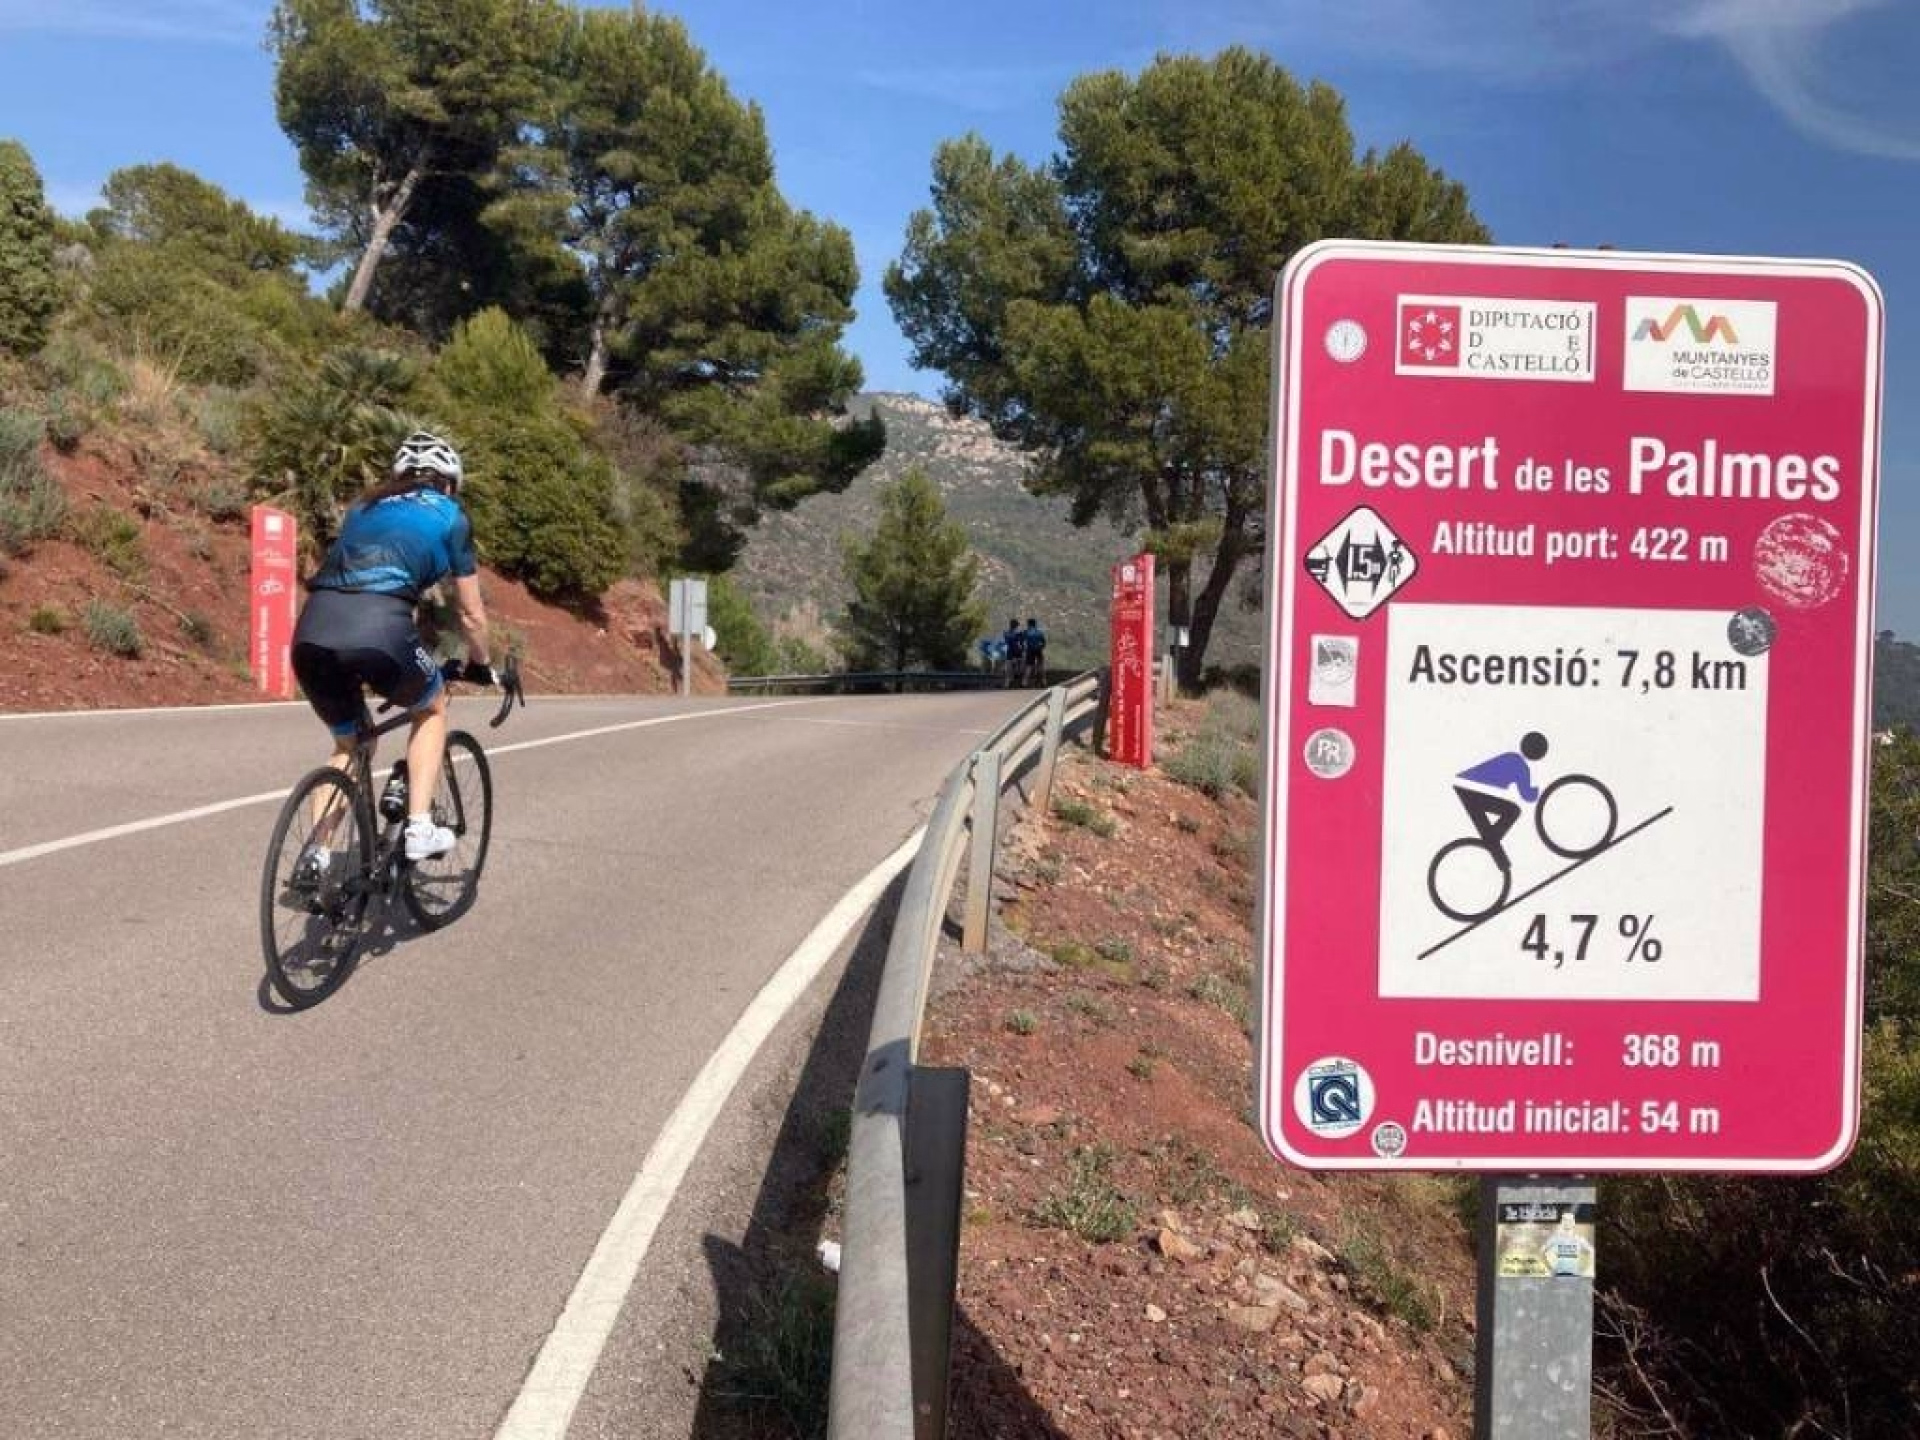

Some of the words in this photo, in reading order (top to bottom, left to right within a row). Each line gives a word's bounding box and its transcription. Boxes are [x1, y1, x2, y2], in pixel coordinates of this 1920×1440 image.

[1469, 309, 1580, 330] DIPUTACIÓ
[1467, 352, 1580, 373] CASTELLÓ
[1672, 351, 1770, 367] MUNTANYES
[1672, 367, 1689, 379] de
[1319, 429, 1500, 490] Desert
[1515, 457, 1554, 492] de
[1564, 459, 1611, 494] les
[1629, 436, 1841, 502] Palmes
[1431, 520, 1535, 557] Altitud
[1546, 527, 1619, 566] port:
[1630, 527, 1690, 562] 422
[1700, 535, 1728, 563] m
[1409, 644, 1600, 688] Ascensió:
[1616, 650, 1676, 695] 7,8
[1691, 651, 1747, 691] km
[1521, 913, 1599, 969] 4,7
[1618, 914, 1663, 963] %
[1414, 1031, 1574, 1066] Desnivell:
[1621, 1033, 1681, 1068] 368
[1690, 1040, 1720, 1068] m
[1412, 1099, 1516, 1133] Altitud
[1524, 1099, 1630, 1133] inicial:
[1640, 1100, 1681, 1133] 54
[1688, 1107, 1720, 1134] m
